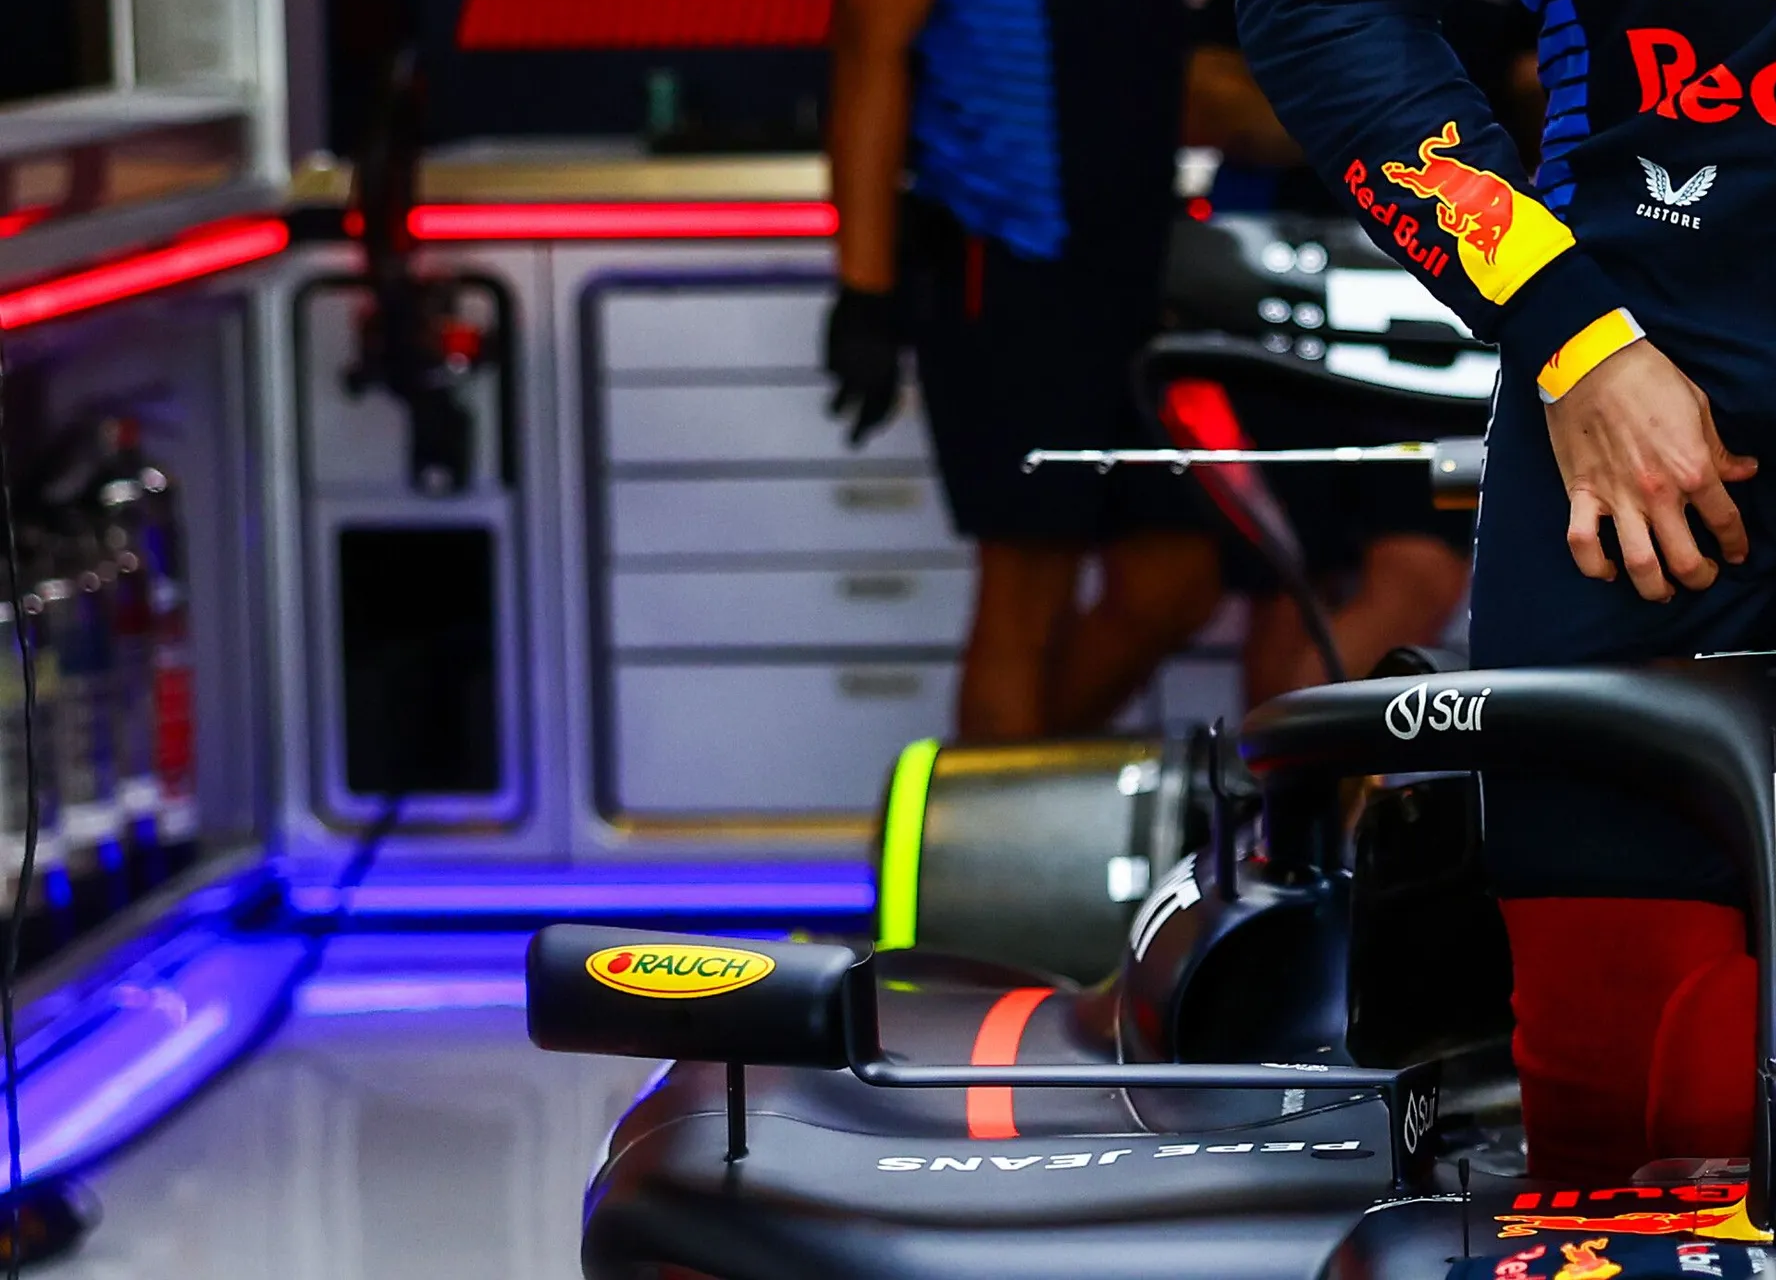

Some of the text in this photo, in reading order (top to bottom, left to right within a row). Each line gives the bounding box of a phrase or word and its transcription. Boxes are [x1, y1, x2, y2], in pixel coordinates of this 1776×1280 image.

[1343, 158, 1449, 278] Red Bull
[1636, 202, 1701, 230] CASTORE
[1429, 687, 1491, 733] Sui
[632, 953, 750, 979] RAUCH
[1418, 1086, 1438, 1132] Sui
[877, 1140, 1362, 1172] PEPE JEANS
